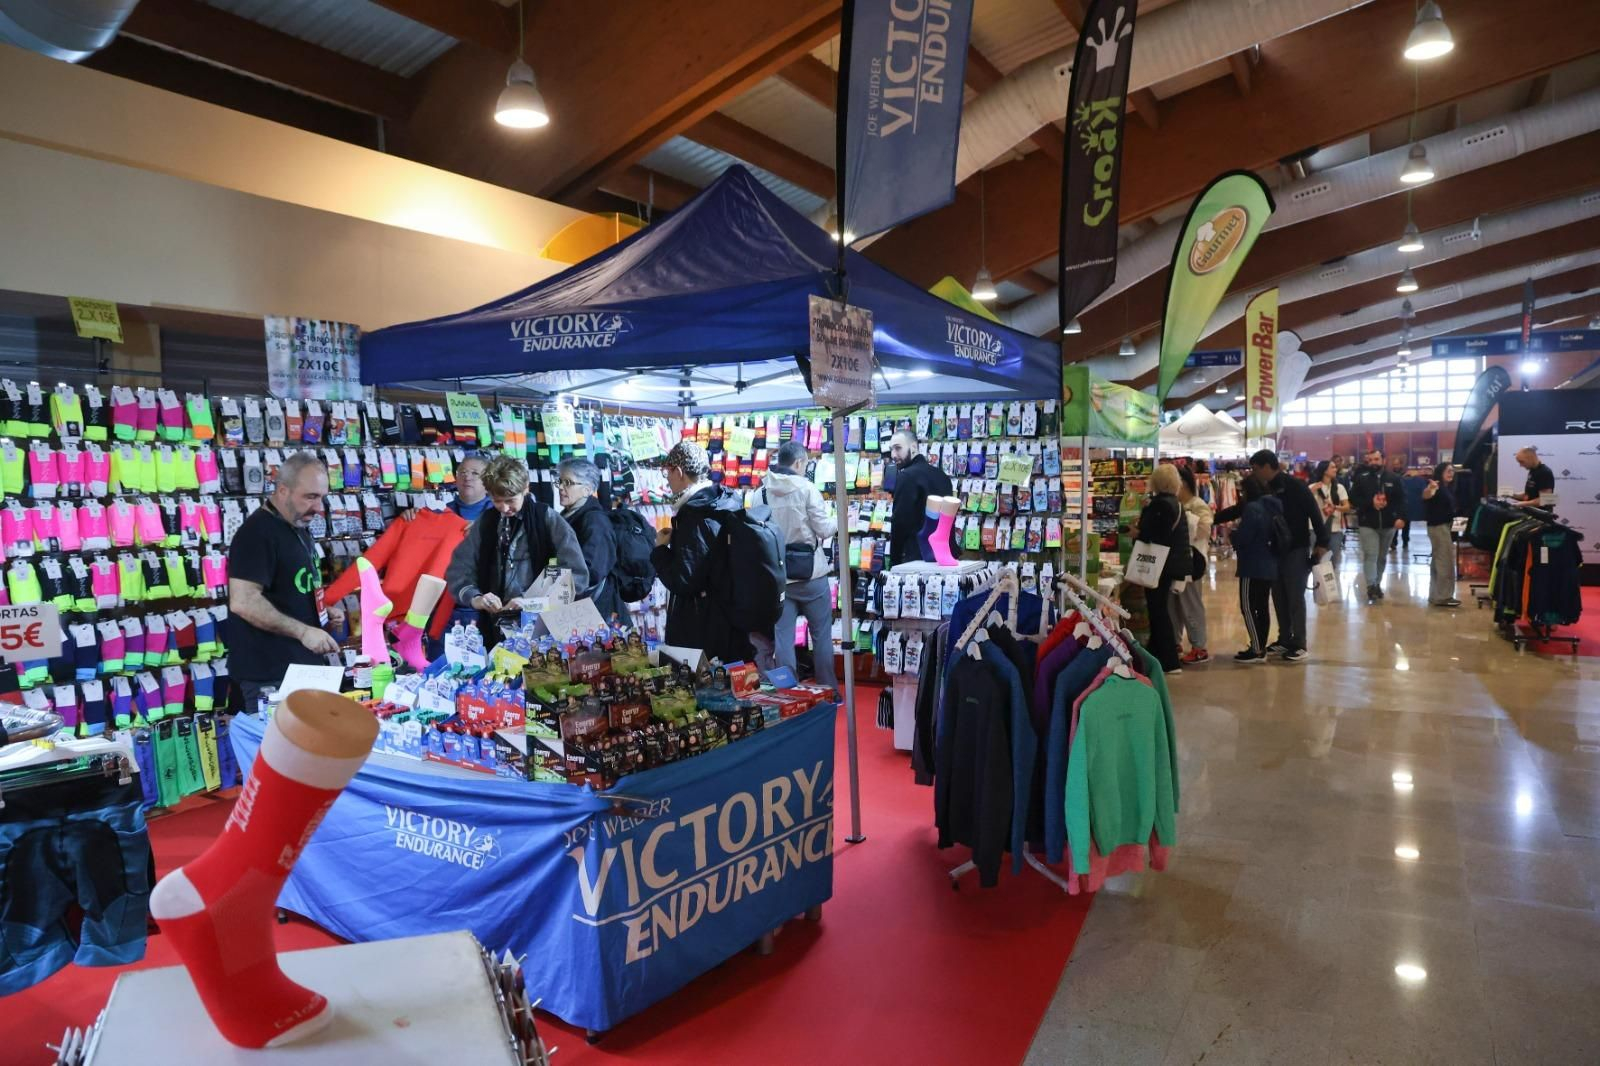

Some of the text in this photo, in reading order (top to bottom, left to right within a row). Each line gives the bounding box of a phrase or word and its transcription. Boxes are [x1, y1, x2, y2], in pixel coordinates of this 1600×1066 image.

[867, 57, 881, 136] JOE WEIDER
[1196, 215, 1240, 267] Gourmet
[510, 312, 604, 338] VICTORY
[947, 322, 993, 350] VICTORY
[522, 333, 612, 353] ENDURANCE
[954, 344, 996, 366] ENDURANCE
[298, 358, 340, 372] 2X10€
[831, 354, 860, 372] 2X10€
[1252, 311, 1274, 413] PowerBar
[0, 606, 39, 619] RTAS
[567, 753, 585, 764] Energy
[385, 805, 476, 847] VICTORY
[567, 760, 823, 918] VICTORY
[396, 832, 481, 870] ENDURANCE
